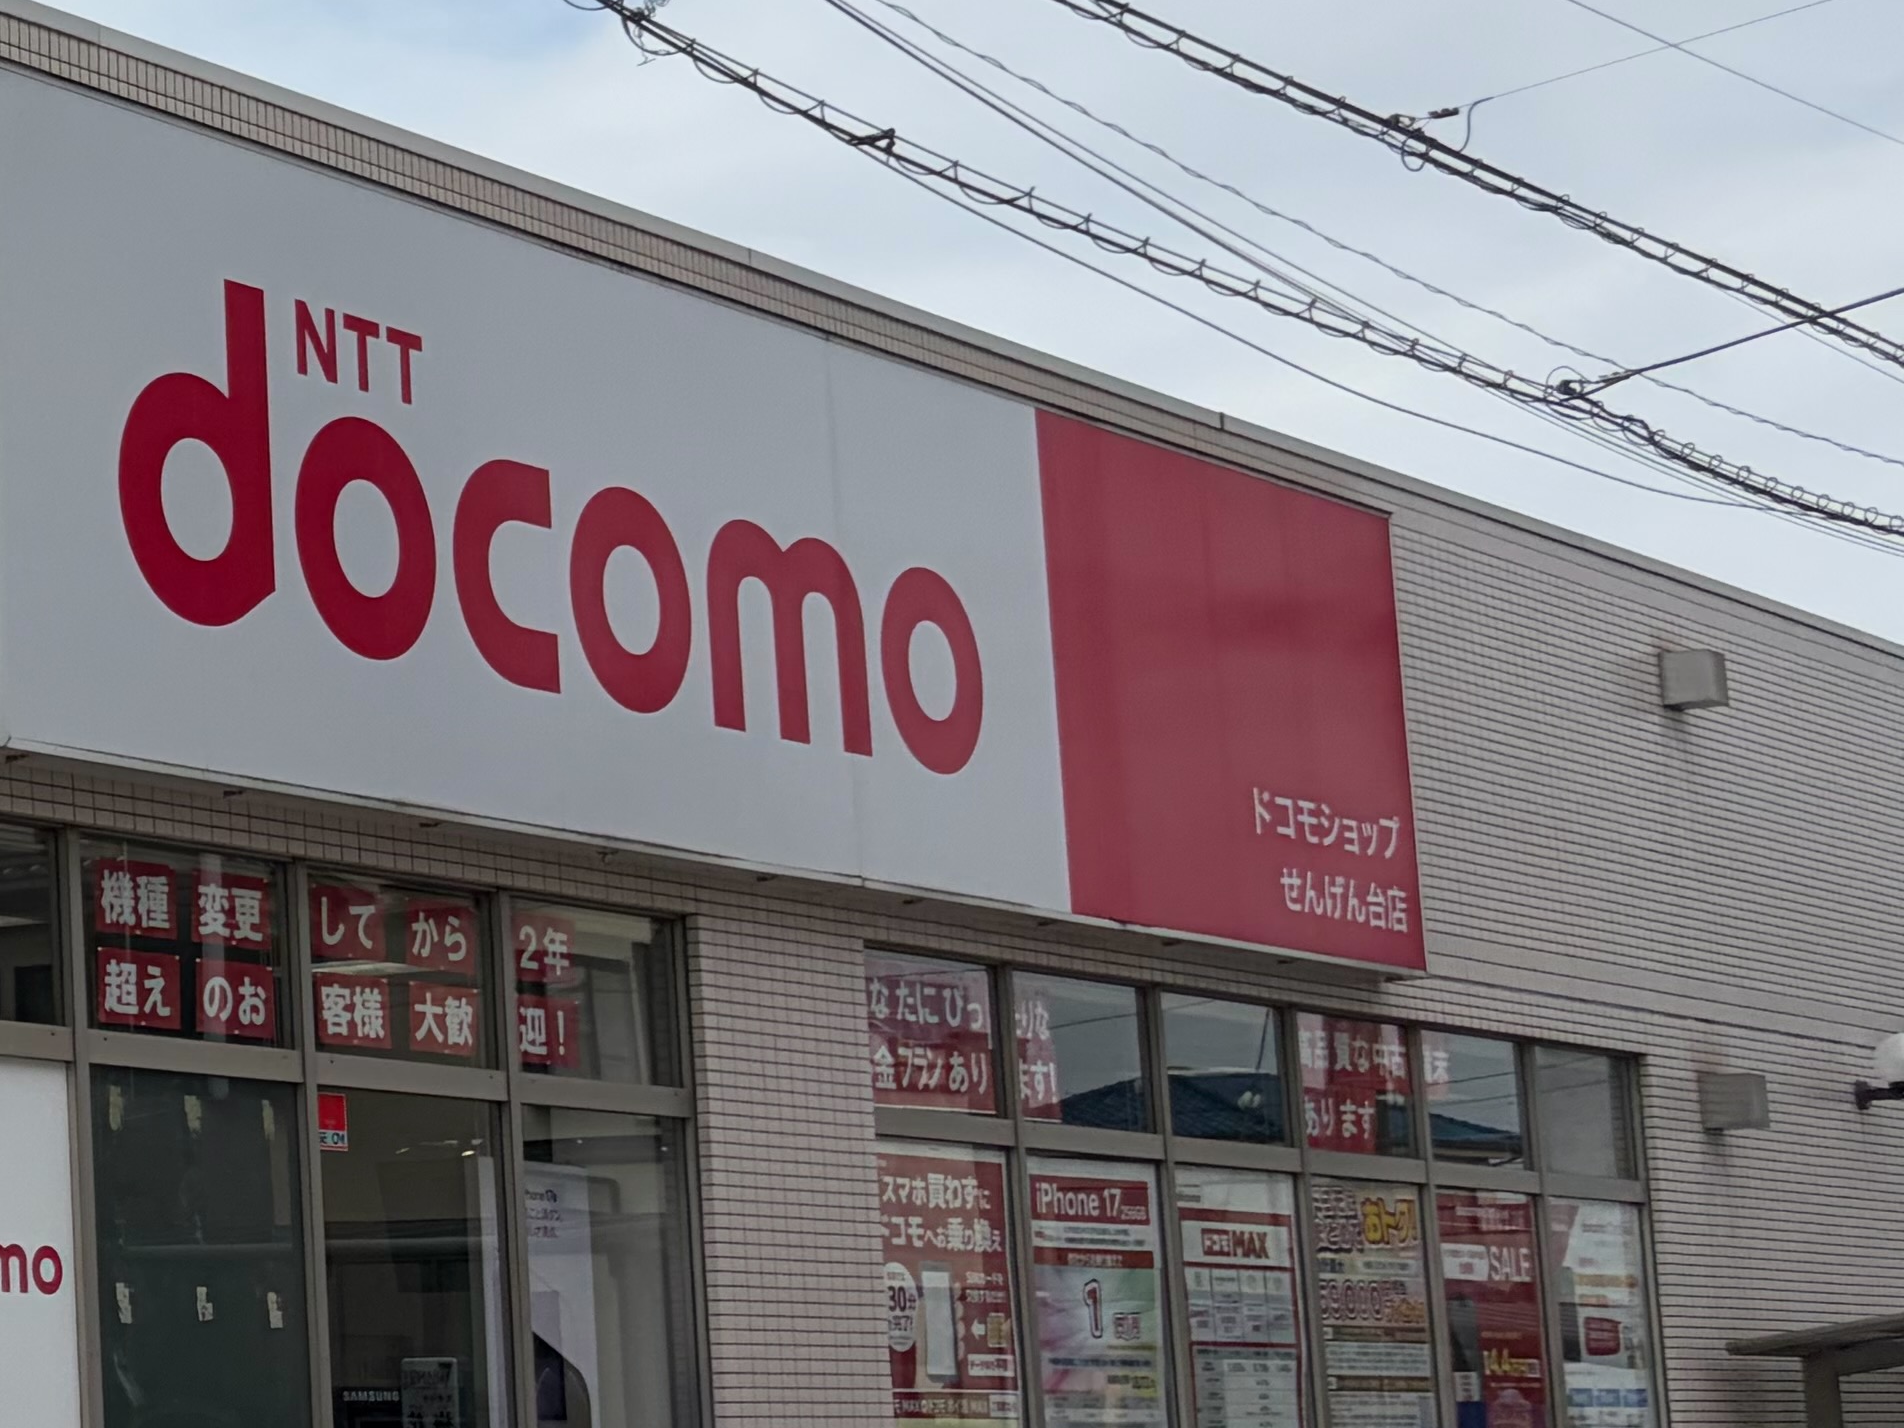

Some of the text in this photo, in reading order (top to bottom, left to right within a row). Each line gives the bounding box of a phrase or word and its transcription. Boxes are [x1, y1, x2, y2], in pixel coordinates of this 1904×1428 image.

[296, 299, 422, 404] NTT
[118, 278, 983, 776] docomo
[1251, 785, 1402, 860] ドコモショップ
[1279, 866, 1409, 936] せんげん台店
[1035, 1181, 1099, 1217] iPhone
[1103, 1188, 1122, 1218] 17
[1489, 1245, 1533, 1283] SALE
[342, 1390, 400, 1402] SAMSUNG
